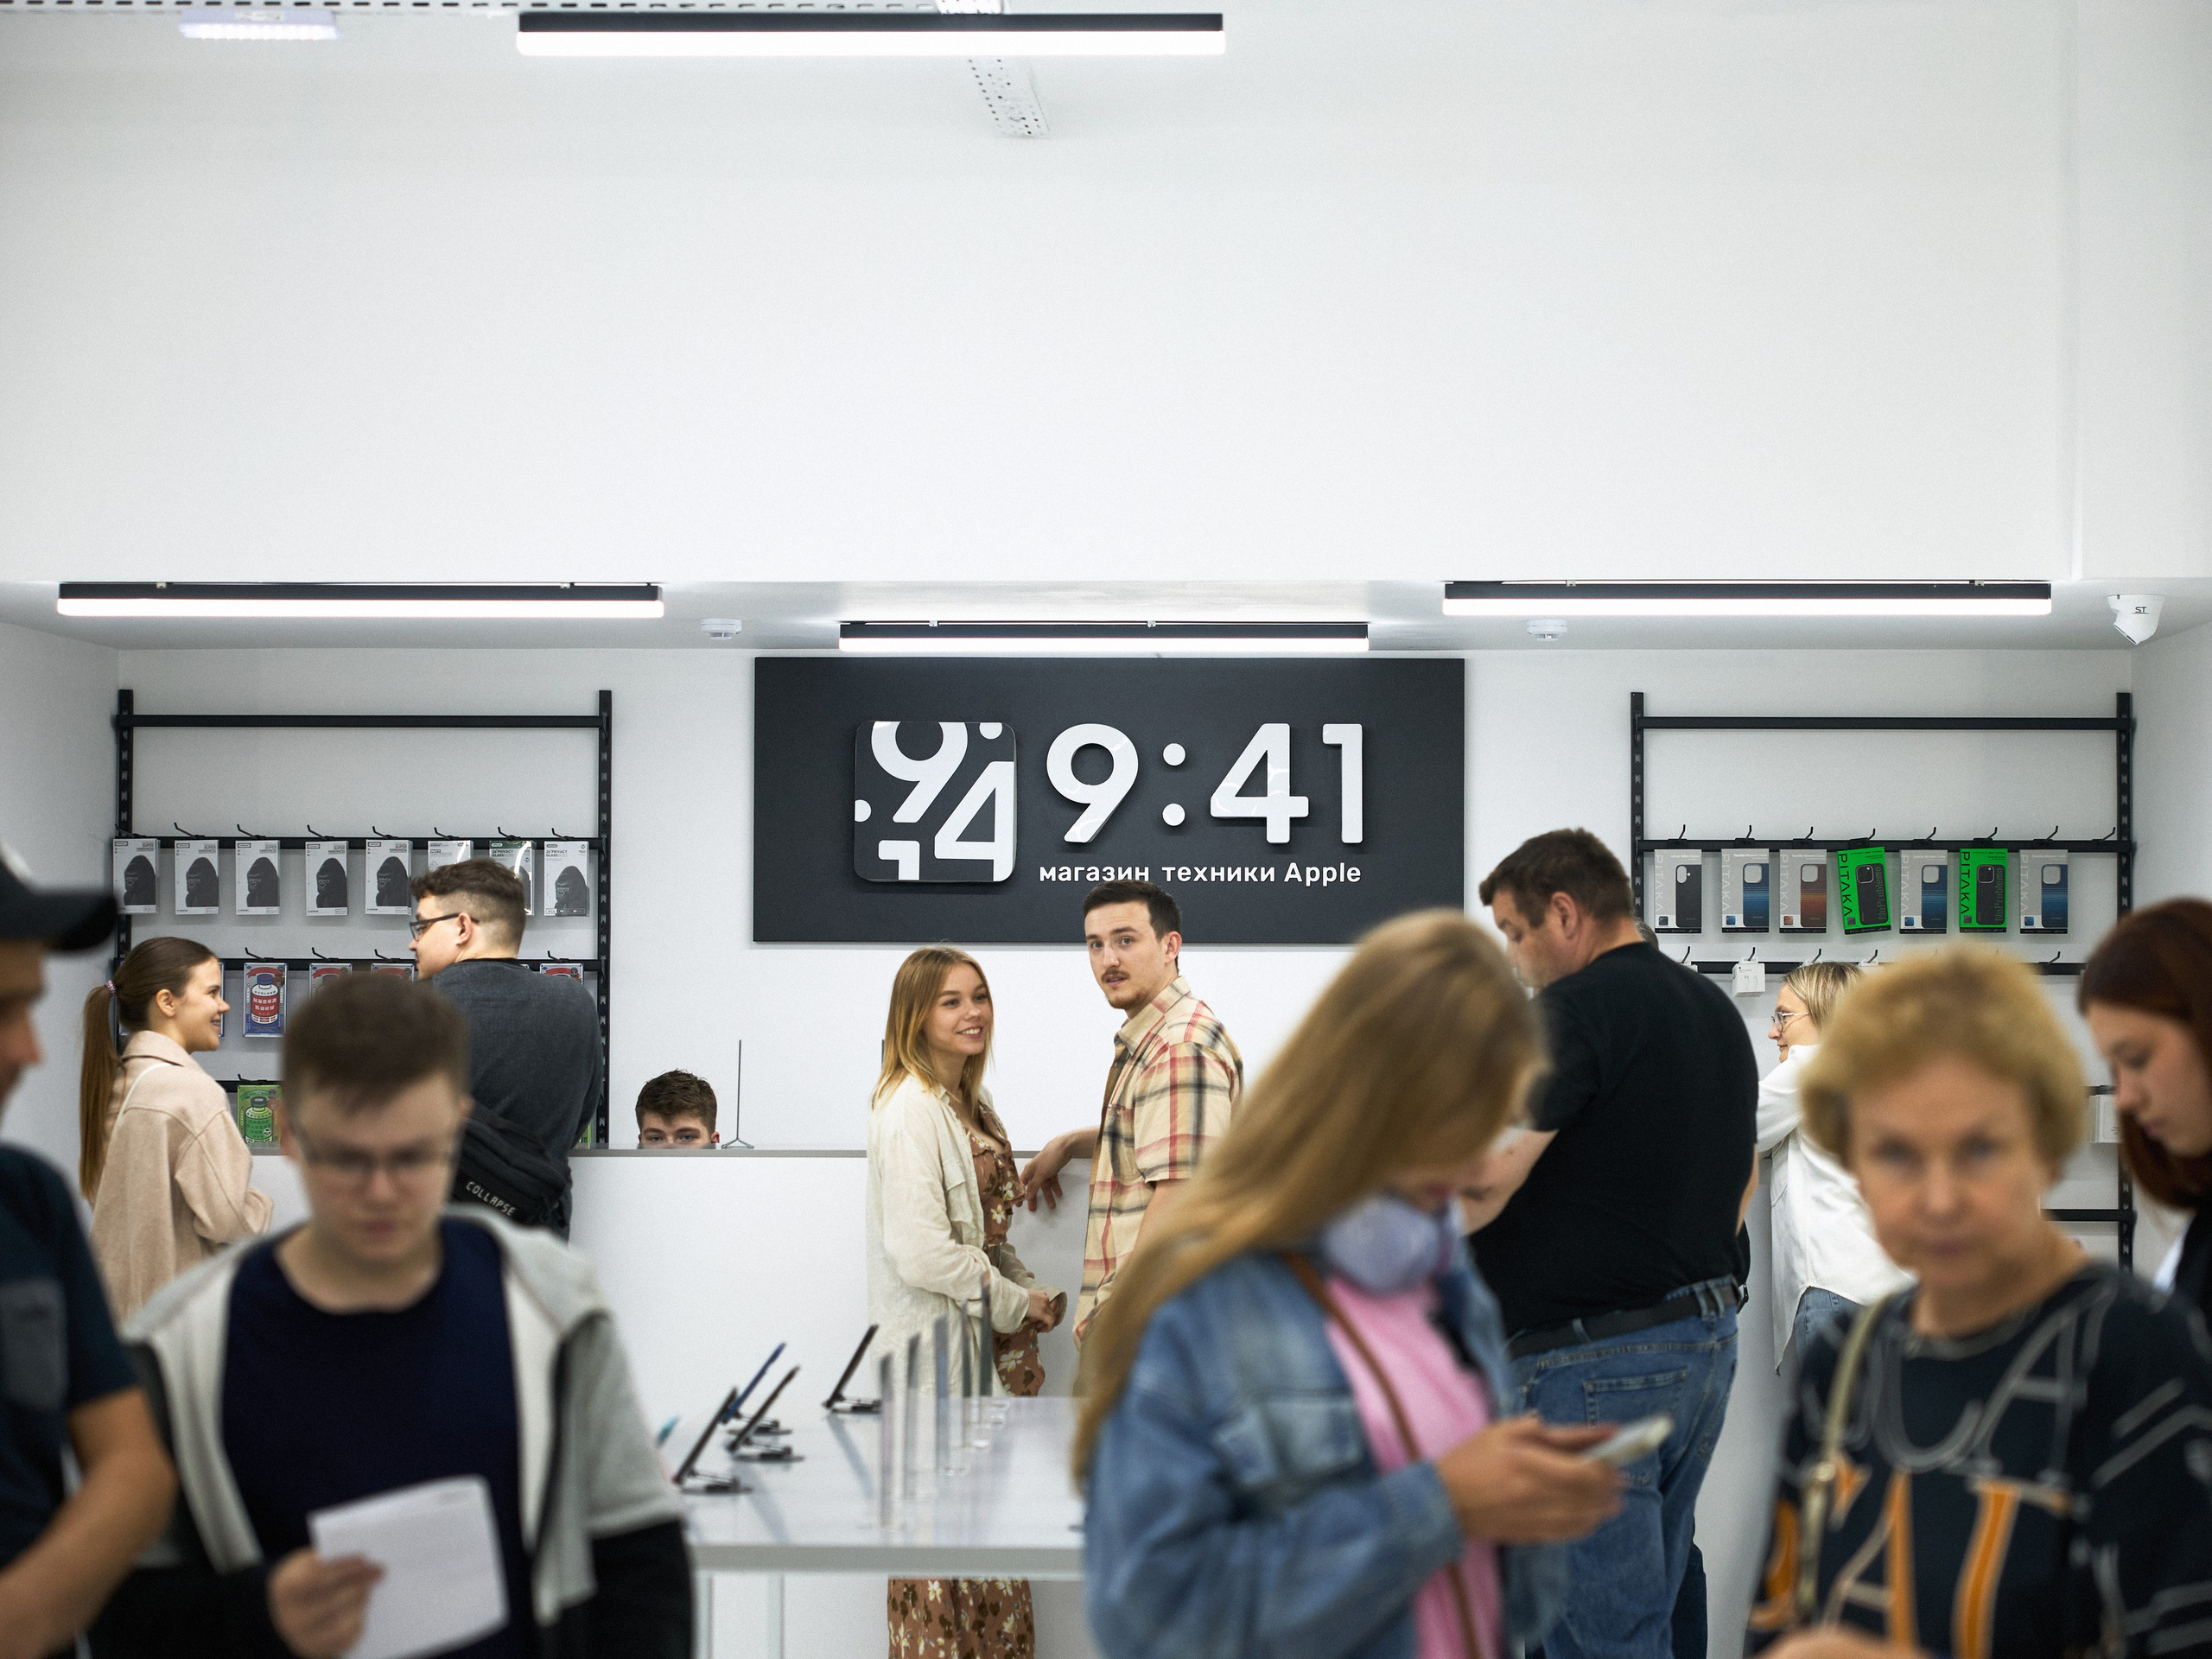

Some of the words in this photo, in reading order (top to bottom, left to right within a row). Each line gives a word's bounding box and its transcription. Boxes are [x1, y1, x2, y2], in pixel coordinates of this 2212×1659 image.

[1046, 722, 1363, 843] 9:41
[1039, 866, 1149, 882] магазин
[1161, 866, 1275, 882] техники
[1283, 861, 1362, 887] Apple
[1655, 854, 1664, 912] PITAKA
[1722, 853, 1731, 912] PITAKA
[1779, 854, 1789, 912] PITAKA
[1838, 853, 1853, 917] PITAKA
[1901, 855, 1910, 912] PITAKA
[1961, 851, 1971, 915] PITAKA
[2020, 855, 2029, 912] PITAKA
[465, 1181, 517, 1217] COLLAPSE
